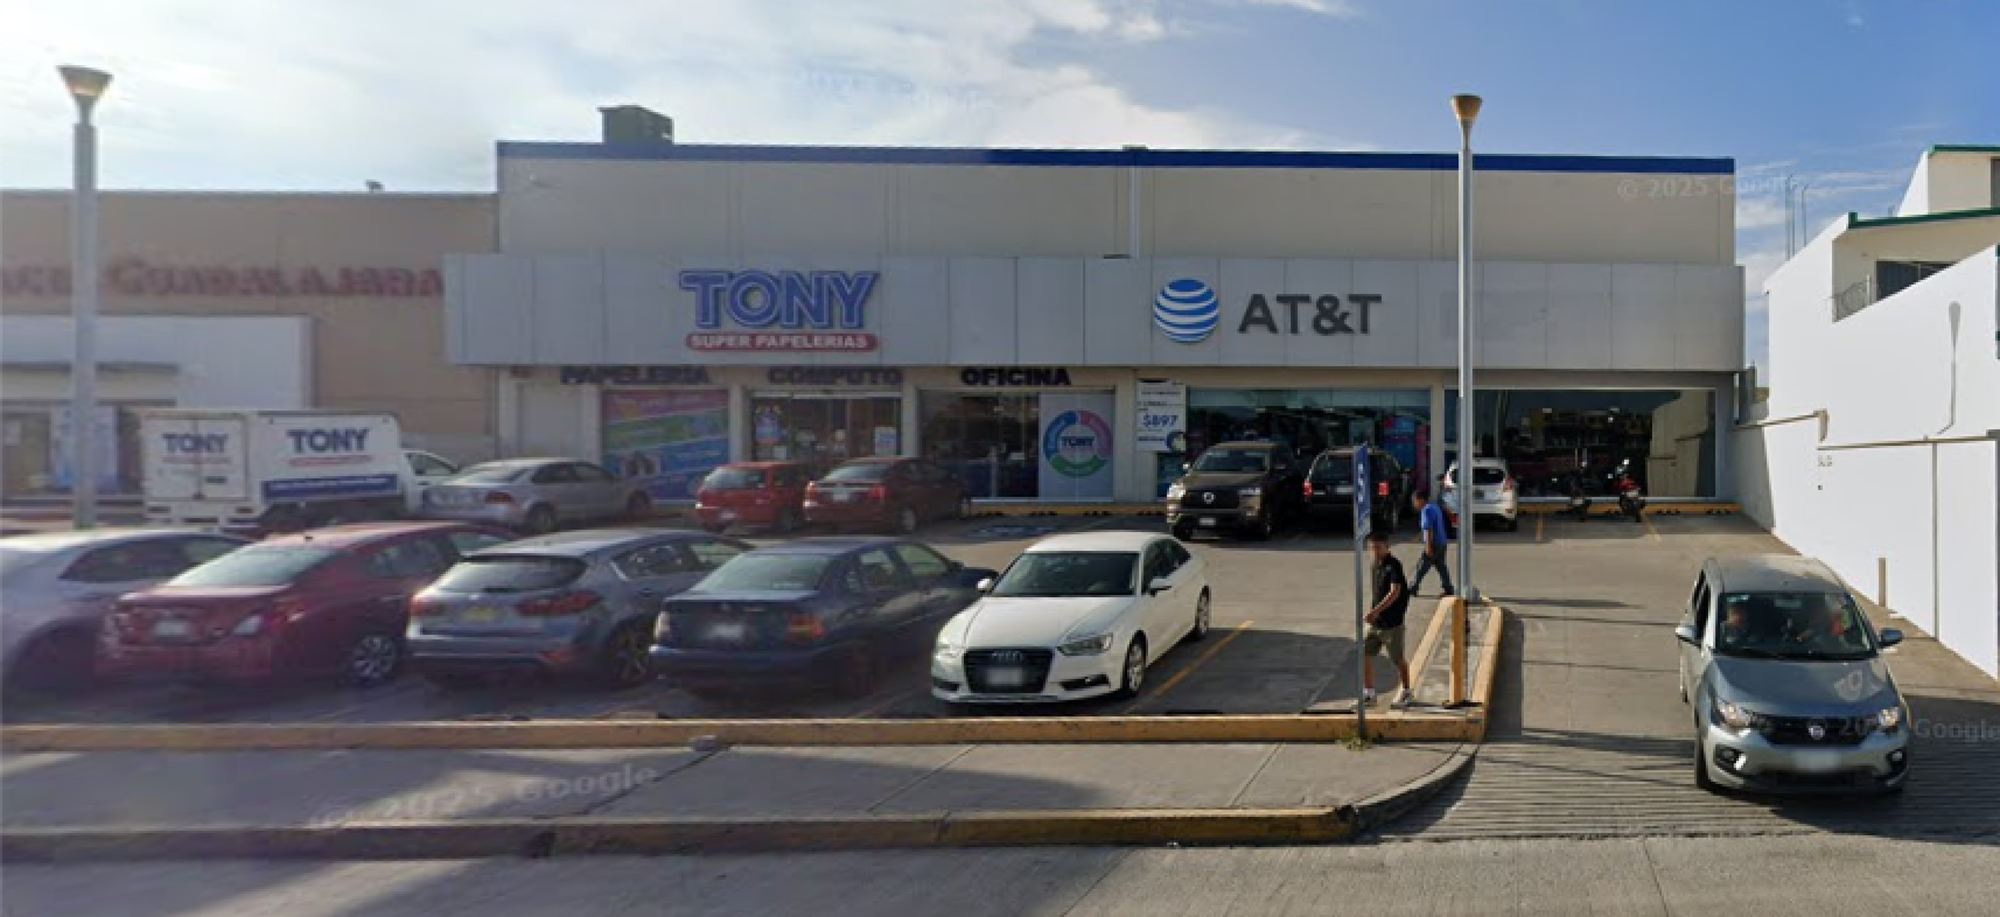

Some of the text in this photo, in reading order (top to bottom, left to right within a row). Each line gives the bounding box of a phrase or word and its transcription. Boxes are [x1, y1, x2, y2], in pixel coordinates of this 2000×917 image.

[679, 270, 881, 329] TONY
[1237, 293, 1383, 336] AT&T
[691, 335, 869, 349] SUPER PAPELERIAS
[961, 367, 1072, 387] OFICINA
[162, 433, 230, 454] TONY
[289, 428, 370, 454] TONY
